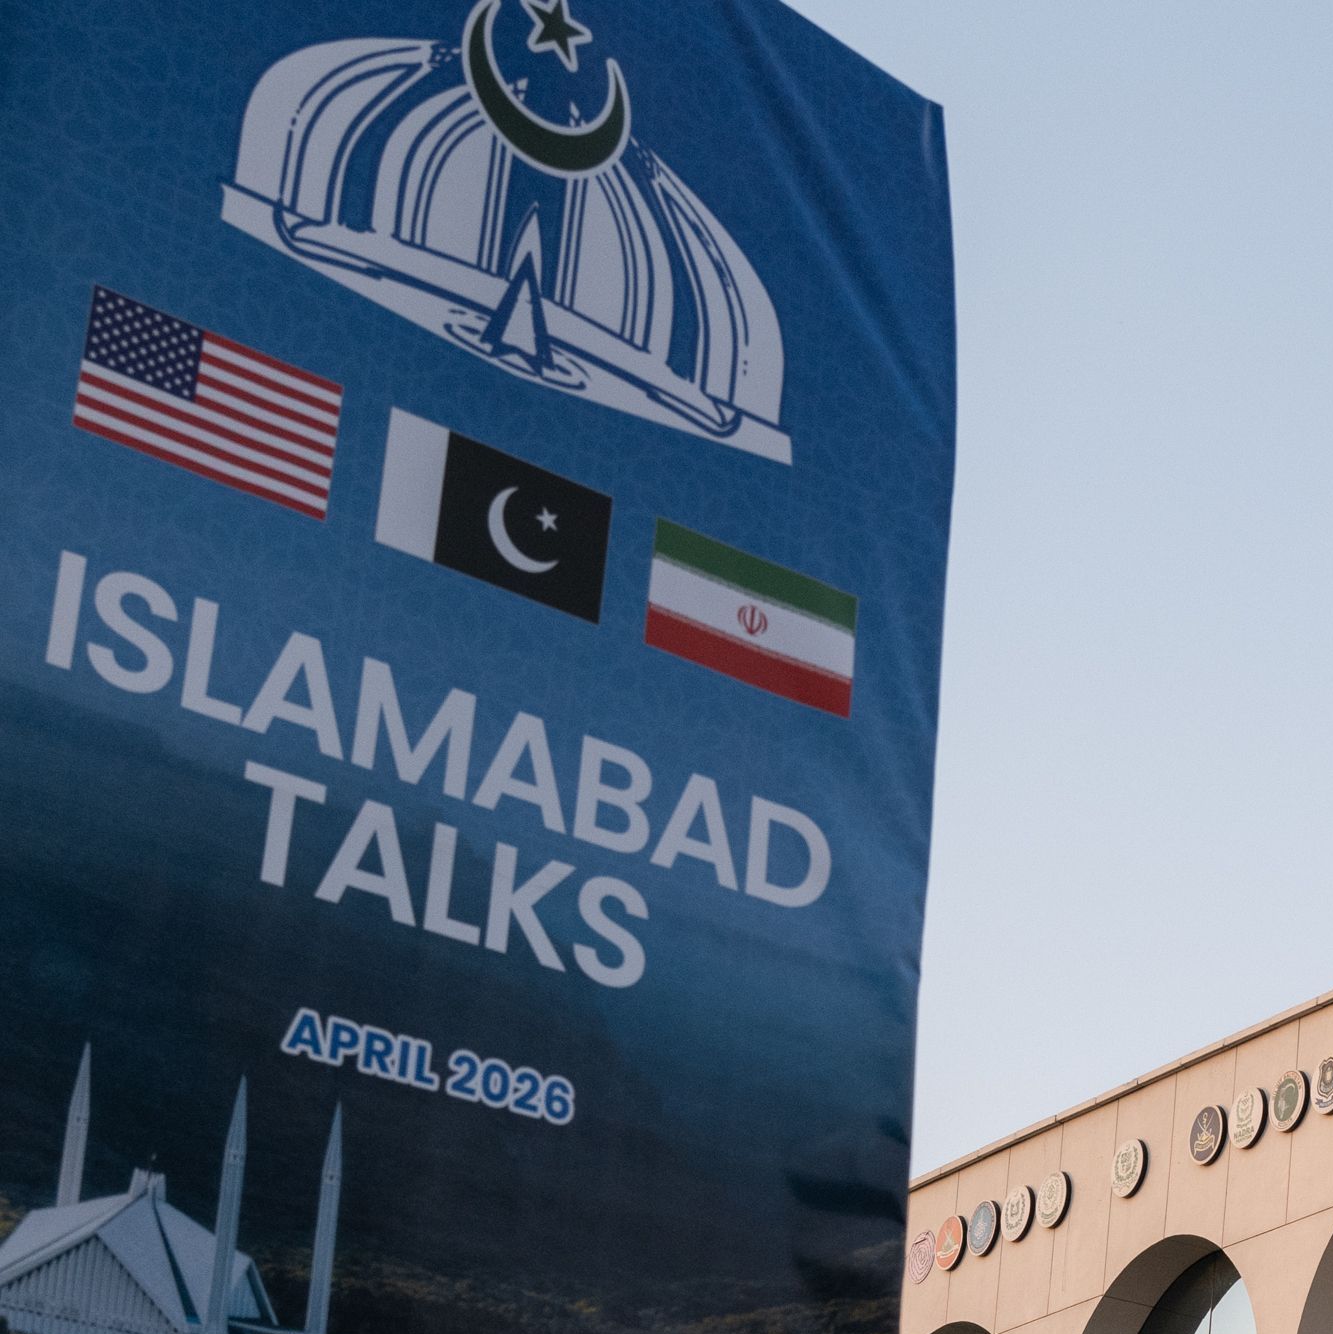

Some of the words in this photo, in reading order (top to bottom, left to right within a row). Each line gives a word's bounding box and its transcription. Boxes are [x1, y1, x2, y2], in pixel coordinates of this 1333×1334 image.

[45, 550, 832, 908] ISLAMABAD
[244, 760, 649, 988] TALKS
[281, 1008, 440, 1091] APRIL
[445, 1049, 575, 1125] 2026
[1233, 1126, 1255, 1140] NADRA
